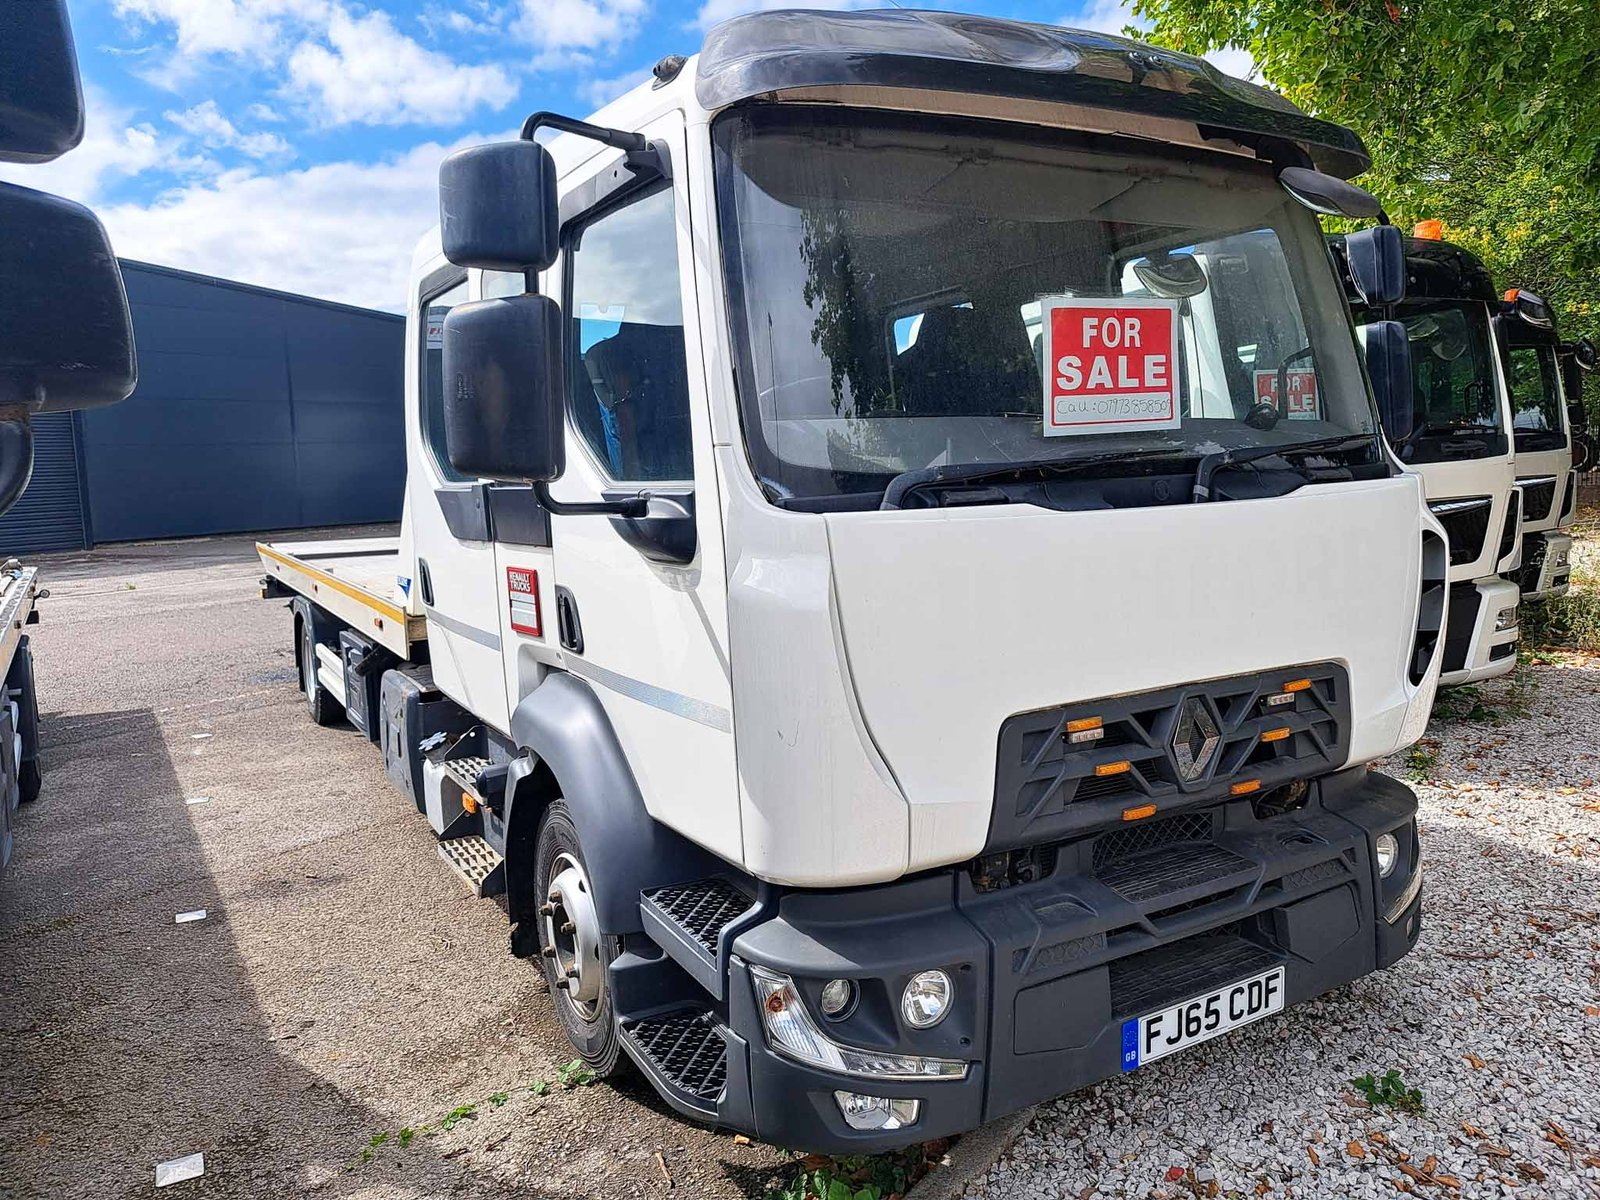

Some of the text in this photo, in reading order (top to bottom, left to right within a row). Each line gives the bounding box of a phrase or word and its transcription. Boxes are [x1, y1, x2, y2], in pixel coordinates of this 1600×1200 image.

[1082, 316, 1141, 348] FOR
[1056, 354, 1168, 391] SALE
[1270, 375, 1301, 392] FR
[510, 580, 531, 592] TRUCKS
[1145, 972, 1280, 1055] FJ65 CDF
[1125, 1050, 1137, 1063] GB
